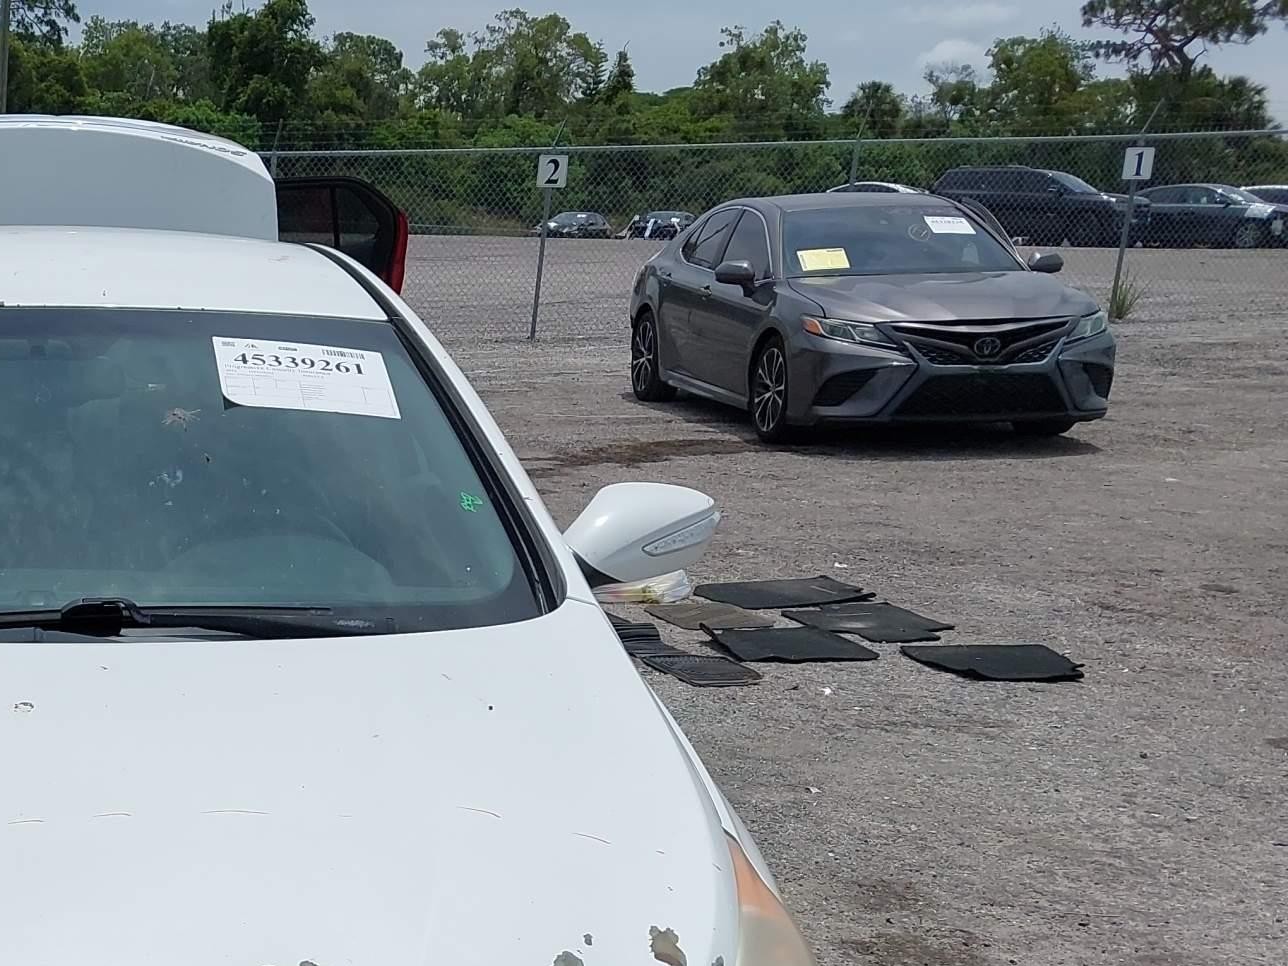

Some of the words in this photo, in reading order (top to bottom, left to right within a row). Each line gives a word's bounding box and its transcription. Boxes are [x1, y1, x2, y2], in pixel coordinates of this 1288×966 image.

[544, 158, 560, 185] 2
[1132, 150, 1145, 177] 1
[233, 352, 366, 376] 45339261
